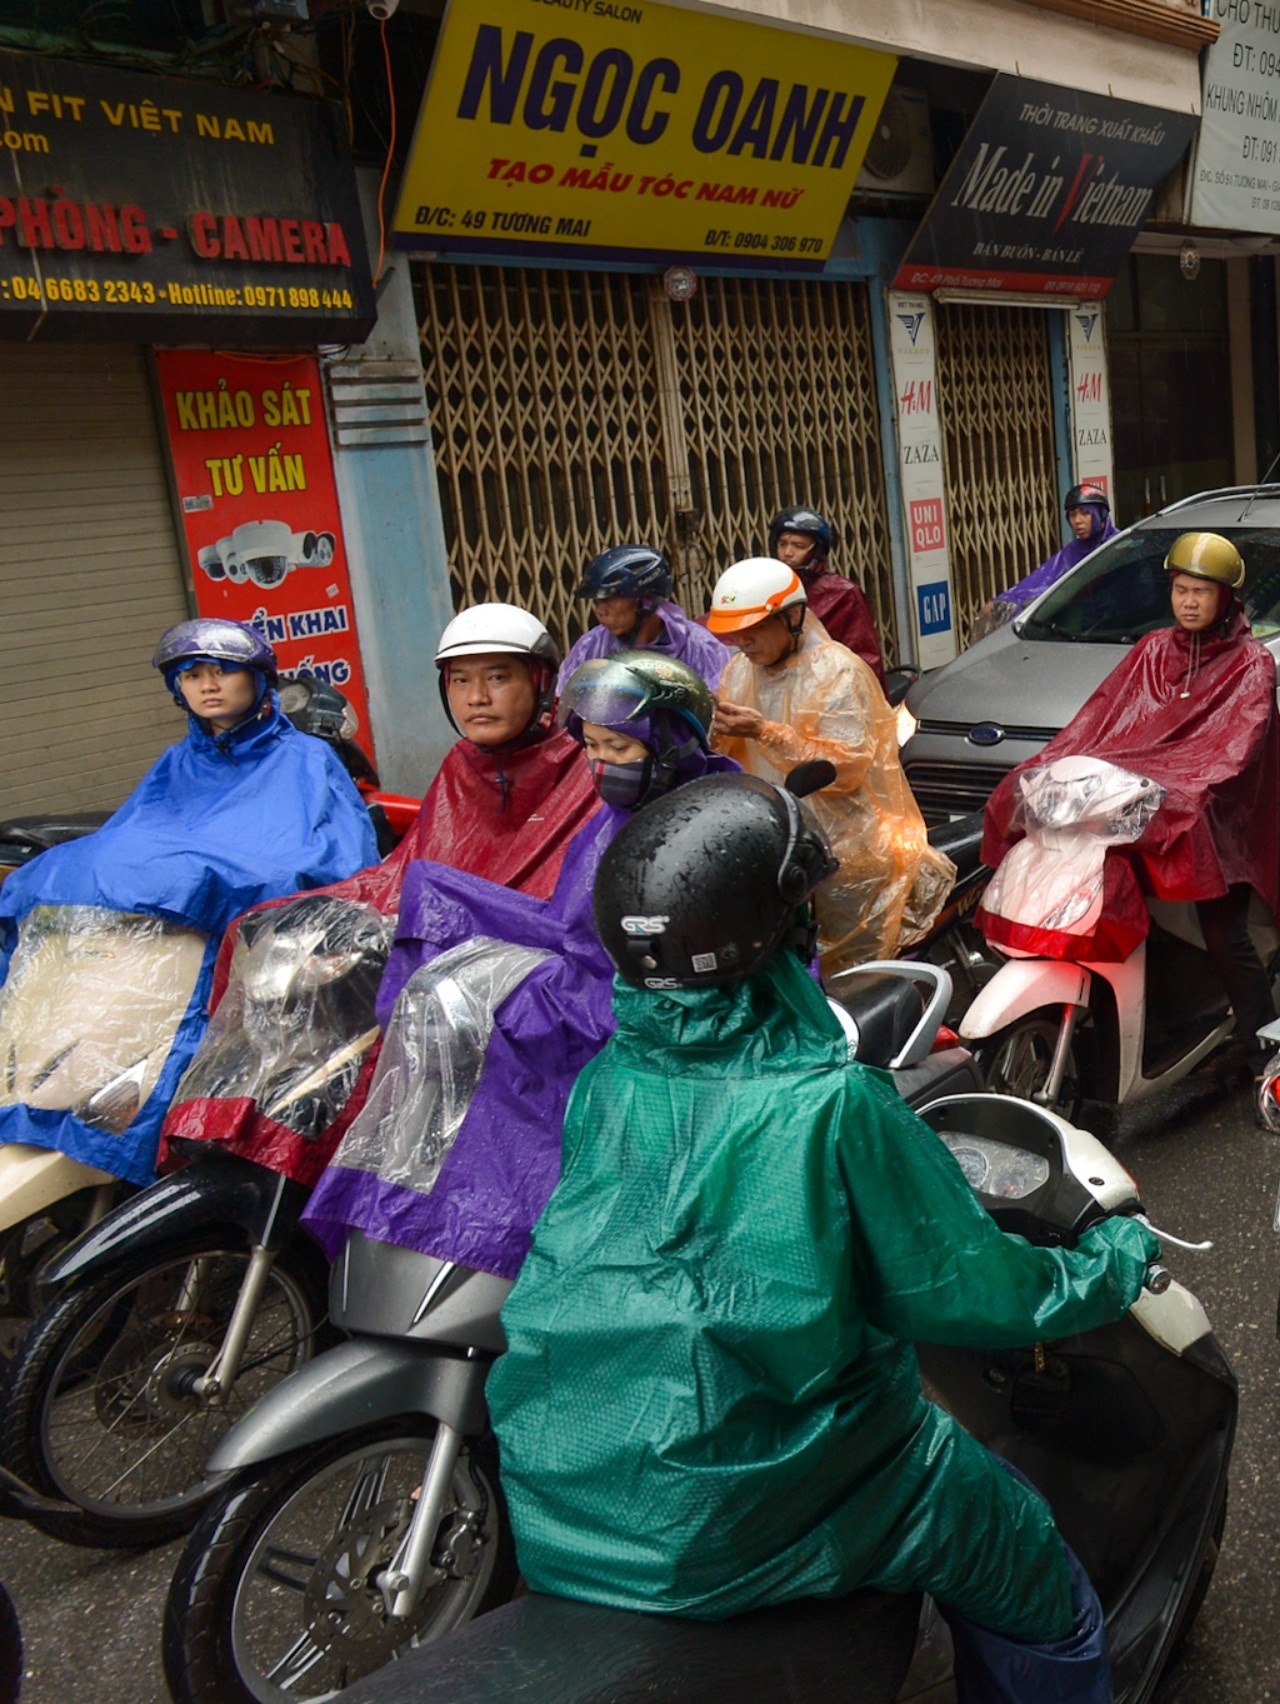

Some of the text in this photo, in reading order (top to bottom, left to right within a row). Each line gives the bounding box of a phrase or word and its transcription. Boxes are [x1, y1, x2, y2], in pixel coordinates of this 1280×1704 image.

[530, 0, 643, 24] AUTY SALON
[1232, 42, 1256, 72] ĐT:
[456, 23, 866, 170] NGỌC OANH
[1206, 83, 1245, 115] KHUNG
[1246, 90, 1277, 122] NHÔM
[26, 90, 86, 122] FIT
[196, 113, 275, 145] NAM
[1019, 102, 1165, 147] THỜI TRANG XUẤT KHẨU
[0, 130, 49, 154] om
[1242, 135, 1259, 161] ĐT:
[1260, 139, 1277, 164] 091
[487, 158, 805, 209] TẠO MẪU TÓC NAM NỮ
[951, 142, 1153, 236] Made in Vietnam
[192, 211, 352, 266] CAMERA
[461, 210, 486, 229] 49
[556, 218, 591, 237] MAI
[734, 232, 768, 249] 0904
[771, 235, 796, 251] 306
[11, 275, 41, 300] 04
[45, 276, 100, 303] 6683
[103, 279, 156, 305] 2343
[167, 281, 243, 307] Hotline:
[245, 286, 286, 307] 0971
[289, 288, 319, 308] 898
[175, 378, 312, 430] KHẢO SÁT
[1078, 428, 1108, 446] ZAZA
[205, 440, 307, 497] TƯ VẤN
[904, 445, 940, 465] ZAZA
[913, 503, 938, 525] UNI
[915, 527, 941, 545] QLO
[289, 606, 347, 638] KHAI
[923, 596, 946, 625] GAP
